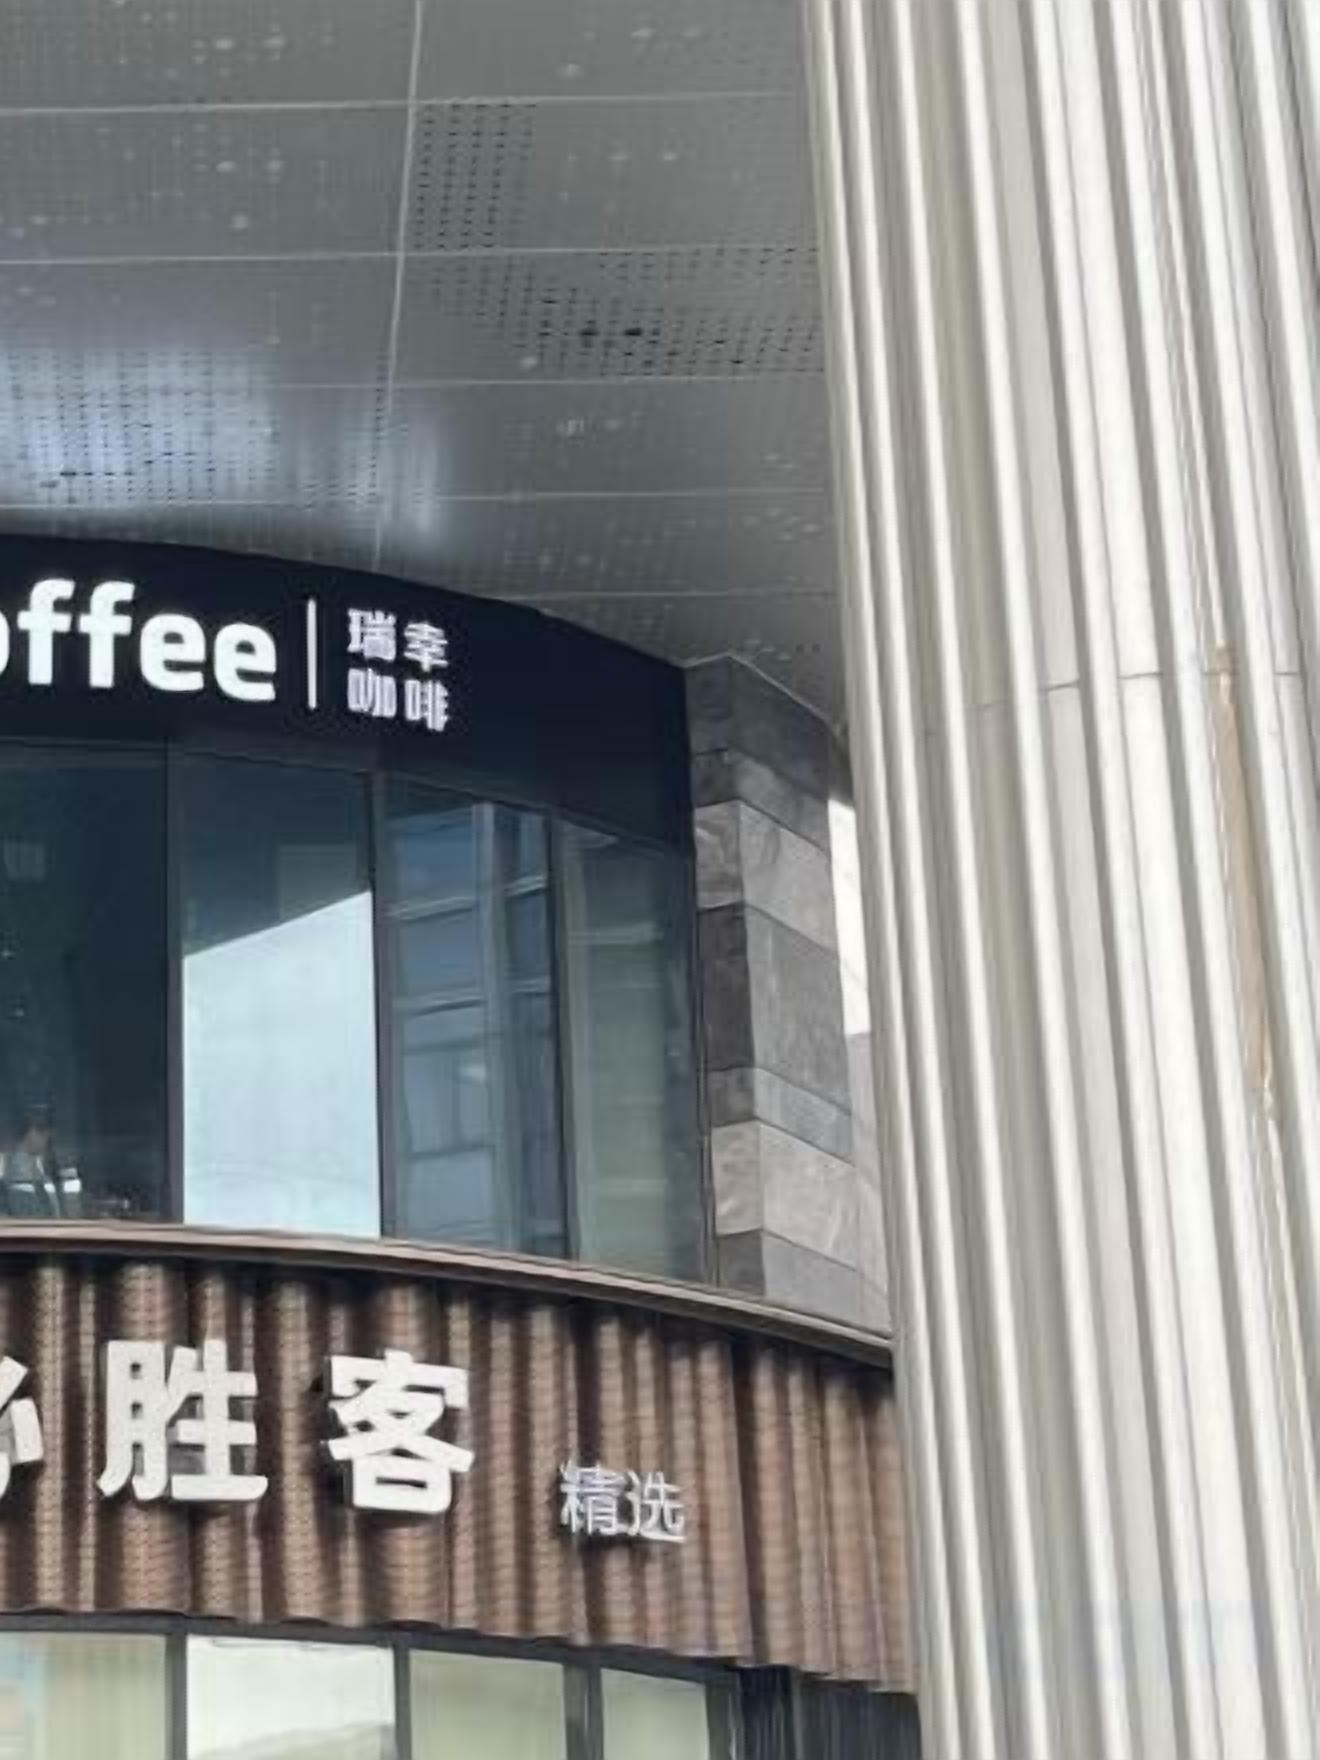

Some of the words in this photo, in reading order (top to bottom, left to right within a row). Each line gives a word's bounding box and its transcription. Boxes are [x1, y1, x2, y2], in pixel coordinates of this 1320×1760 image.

[347, 608, 449, 672] 瑞幸
[347, 667, 449, 732] 咖啡
[560, 1460, 685, 1542] 精选
